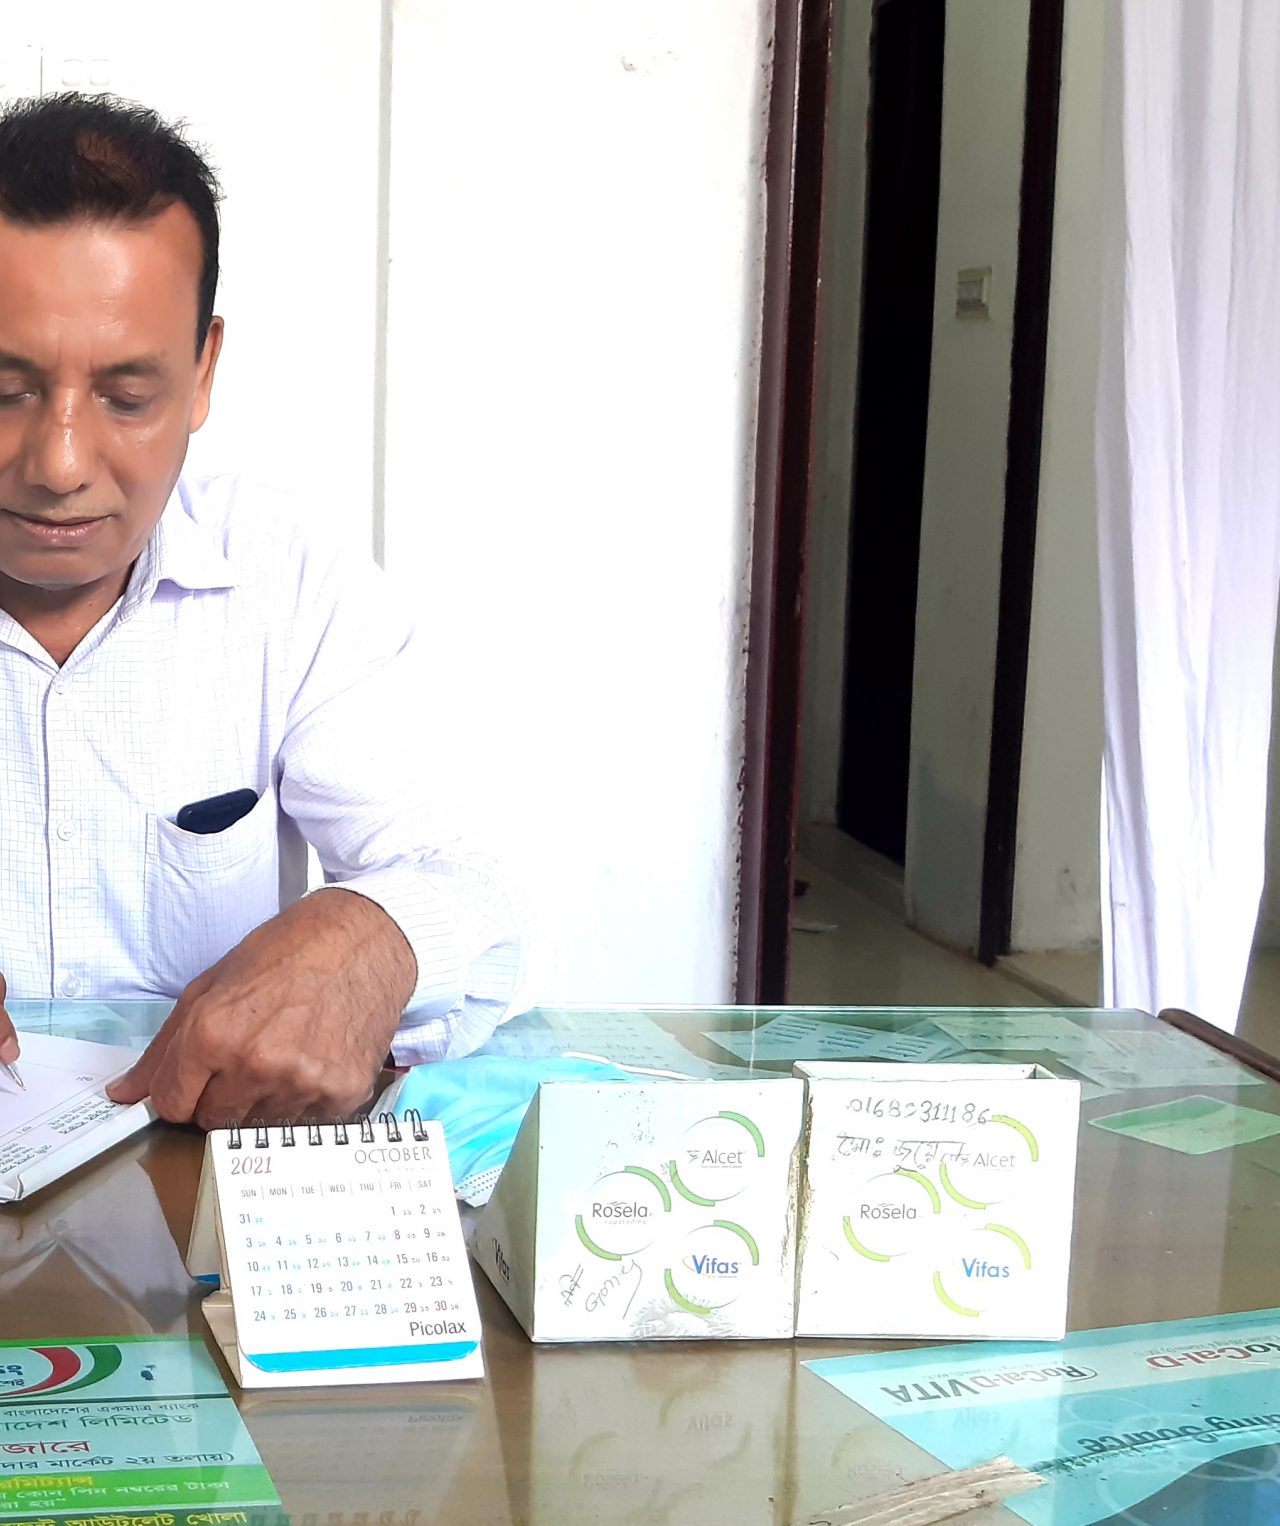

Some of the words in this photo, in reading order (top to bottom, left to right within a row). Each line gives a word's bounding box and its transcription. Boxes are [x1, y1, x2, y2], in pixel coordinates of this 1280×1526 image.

[353, 1145, 433, 1165] OCTOBER
[701, 1149, 743, 1164] Alcet
[973, 1152, 1016, 1168] Alcet
[229, 1155, 273, 1176] 2021
[240, 1188, 257, 1198] SUN
[269, 1186, 288, 1197] MON
[300, 1185, 316, 1195] TUE
[328, 1184, 346, 1194] WED
[359, 1182, 375, 1192] THU
[388, 1180, 403, 1190] FRI
[417, 1178, 433, 1189] SAT
[239, 1213, 251, 1225] 31
[390, 1206, 396, 1217] 1
[419, 1204, 426, 1215] 2
[592, 1201, 649, 1218] Rosela
[860, 1203, 917, 1221] Rosela
[246, 1237, 253, 1248] 3
[275, 1235, 282, 1246] 4
[305, 1234, 312, 1245] 5
[335, 1232, 342, 1244] 6
[365, 1231, 371, 1242] 7
[394, 1229, 401, 1240] 8
[423, 1228, 431, 1239] 9
[247, 1261, 260, 1273] 10
[277, 1259, 289, 1270] 11
[307, 1258, 319, 1269] 12
[337, 1256, 349, 1268] 13
[367, 1255, 379, 1266] 14
[396, 1254, 408, 1264] 15
[426, 1252, 438, 1263] 16
[691, 1254, 739, 1275] Vifas
[961, 1257, 1010, 1279] Vifas
[250, 1285, 262, 1296] 17
[280, 1284, 293, 1295] 18
[311, 1282, 323, 1294] 19
[340, 1281, 353, 1292] 20
[370, 1279, 383, 1290] 21
[399, 1278, 413, 1289] 22
[429, 1276, 443, 1287] 23
[253, 1310, 266, 1322] 24
[283, 1308, 297, 1320] 25
[314, 1307, 327, 1319] 26
[344, 1305, 357, 1317] 27
[374, 1303, 387, 1315] 28
[404, 1302, 417, 1314] 29
[434, 1300, 447, 1312] 30
[408, 1319, 467, 1337] Picolax
[79, 1414, 193, 1428] লিমিটেড
